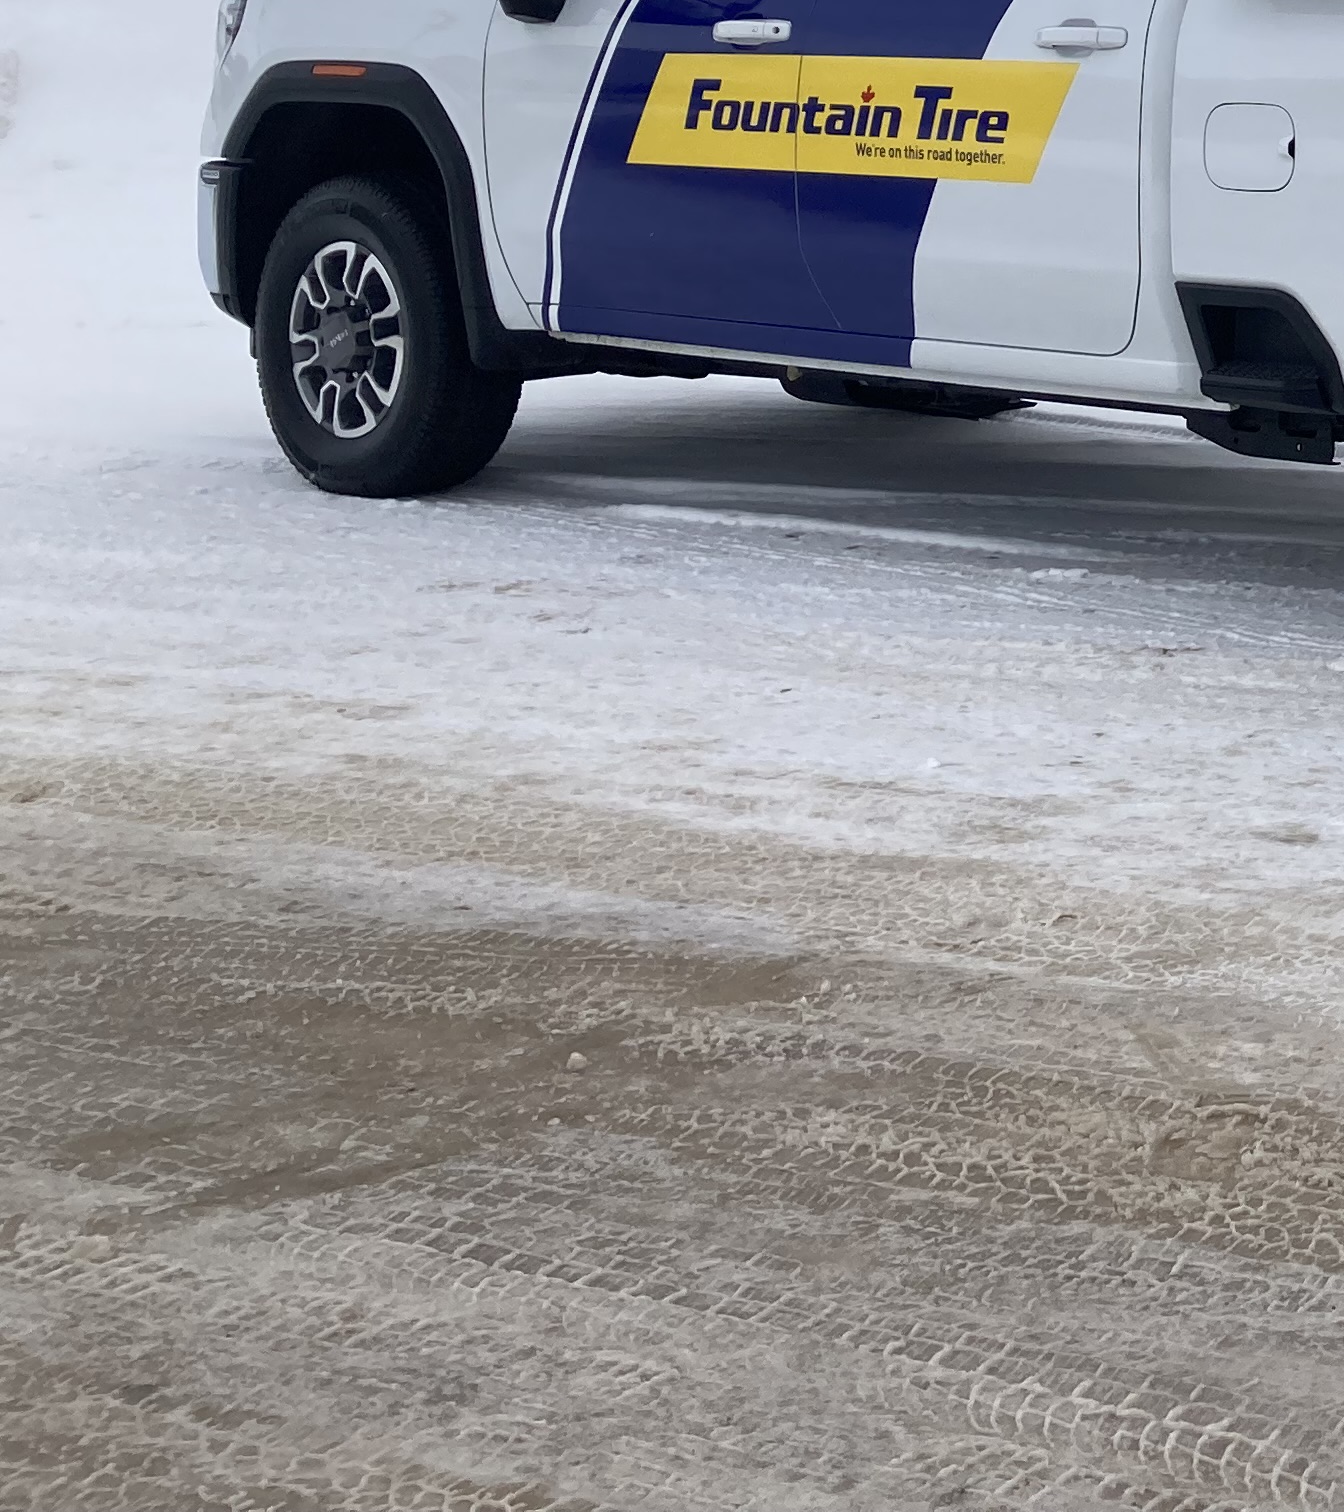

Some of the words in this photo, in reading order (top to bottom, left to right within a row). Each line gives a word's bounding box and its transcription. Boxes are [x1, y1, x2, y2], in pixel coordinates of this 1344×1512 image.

[684, 78, 902, 138] Fountain
[913, 85, 1010, 144] Tire
[855, 141, 886, 158] We're
[888, 147, 902, 159] on
[904, 145, 924, 160] this
[927, 147, 953, 162] road
[955, 148, 1006, 166] together.
